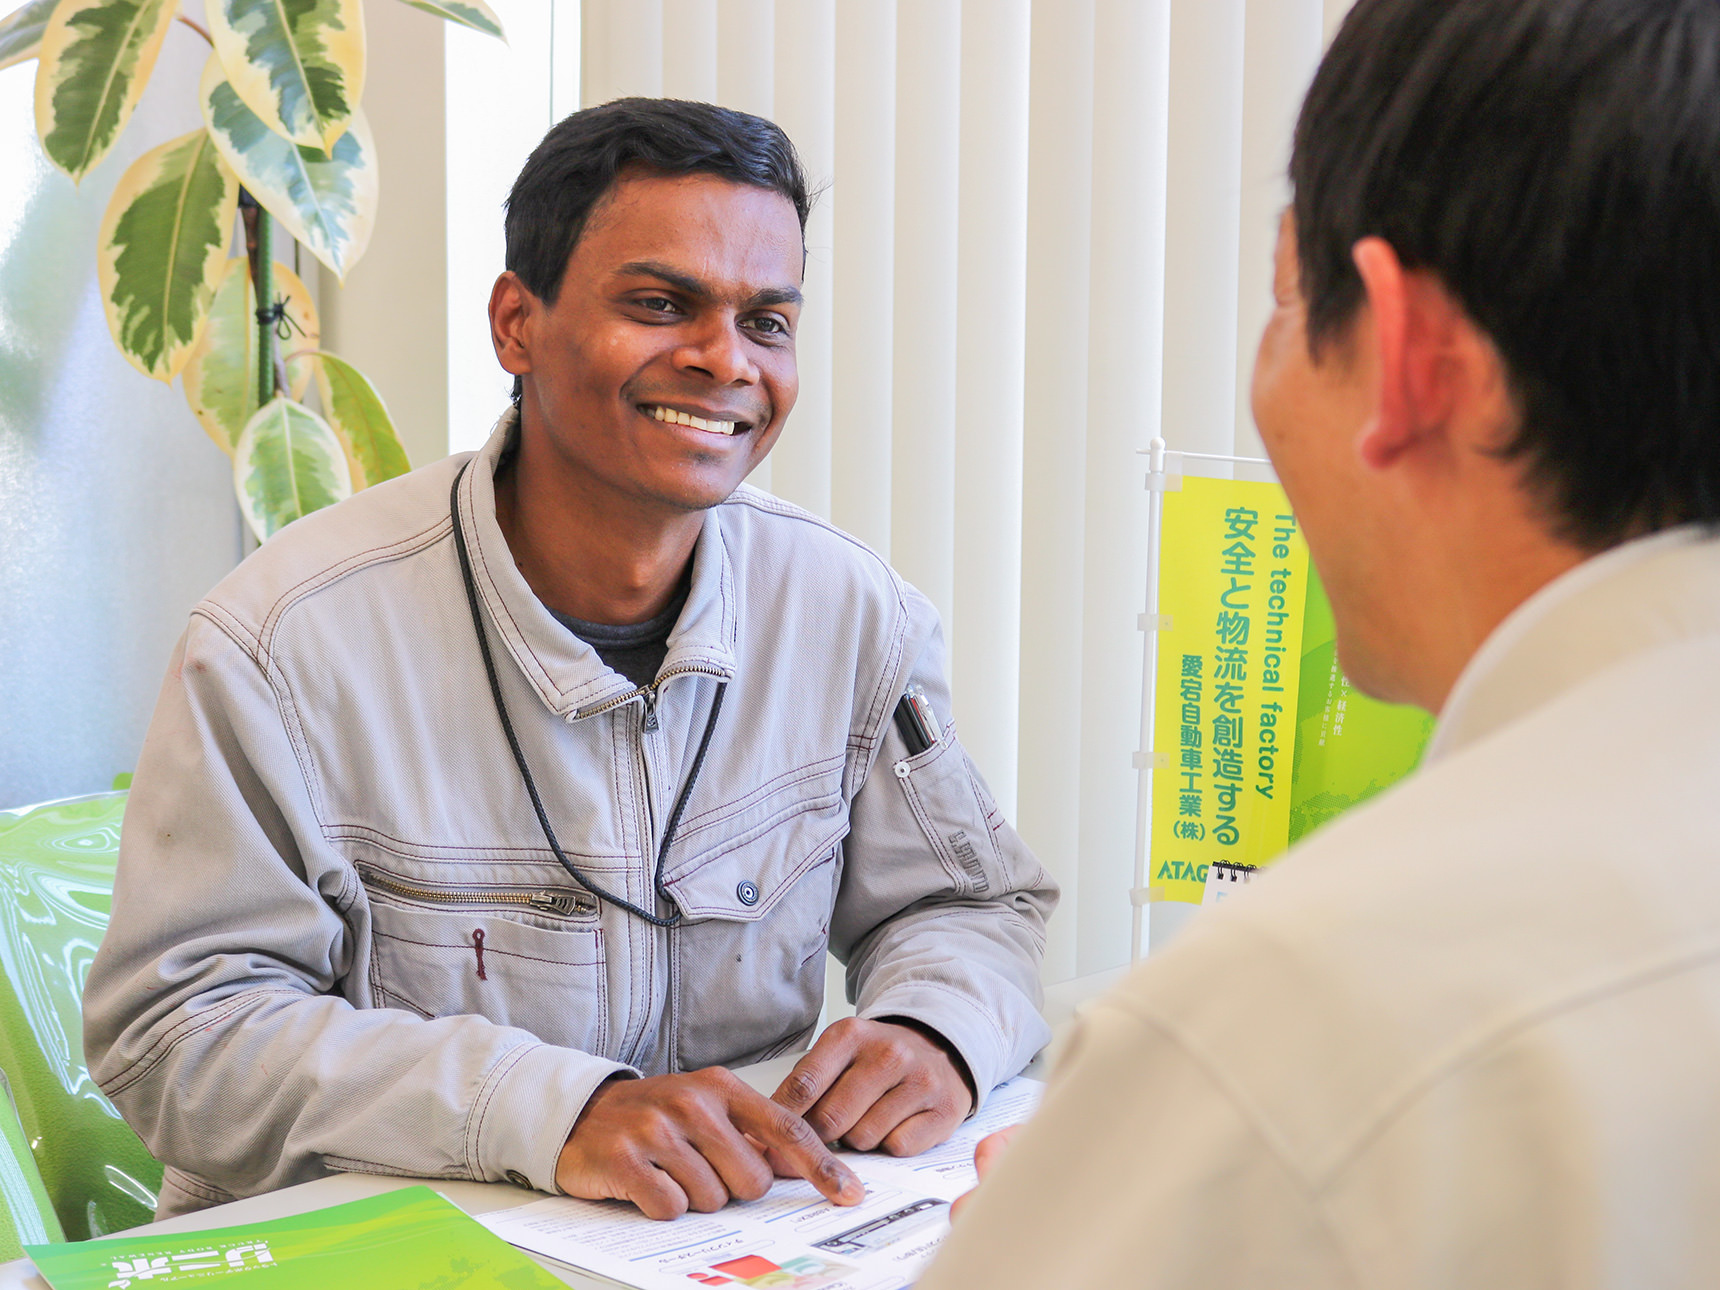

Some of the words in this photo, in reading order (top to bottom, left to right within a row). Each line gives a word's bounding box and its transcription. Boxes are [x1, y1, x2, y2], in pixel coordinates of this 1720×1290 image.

[1272, 510, 1297, 559] The
[1212, 506, 1259, 846] 安全と物流を創造する
[1262, 568, 1292, 691] technical
[1255, 702, 1284, 799] factory
